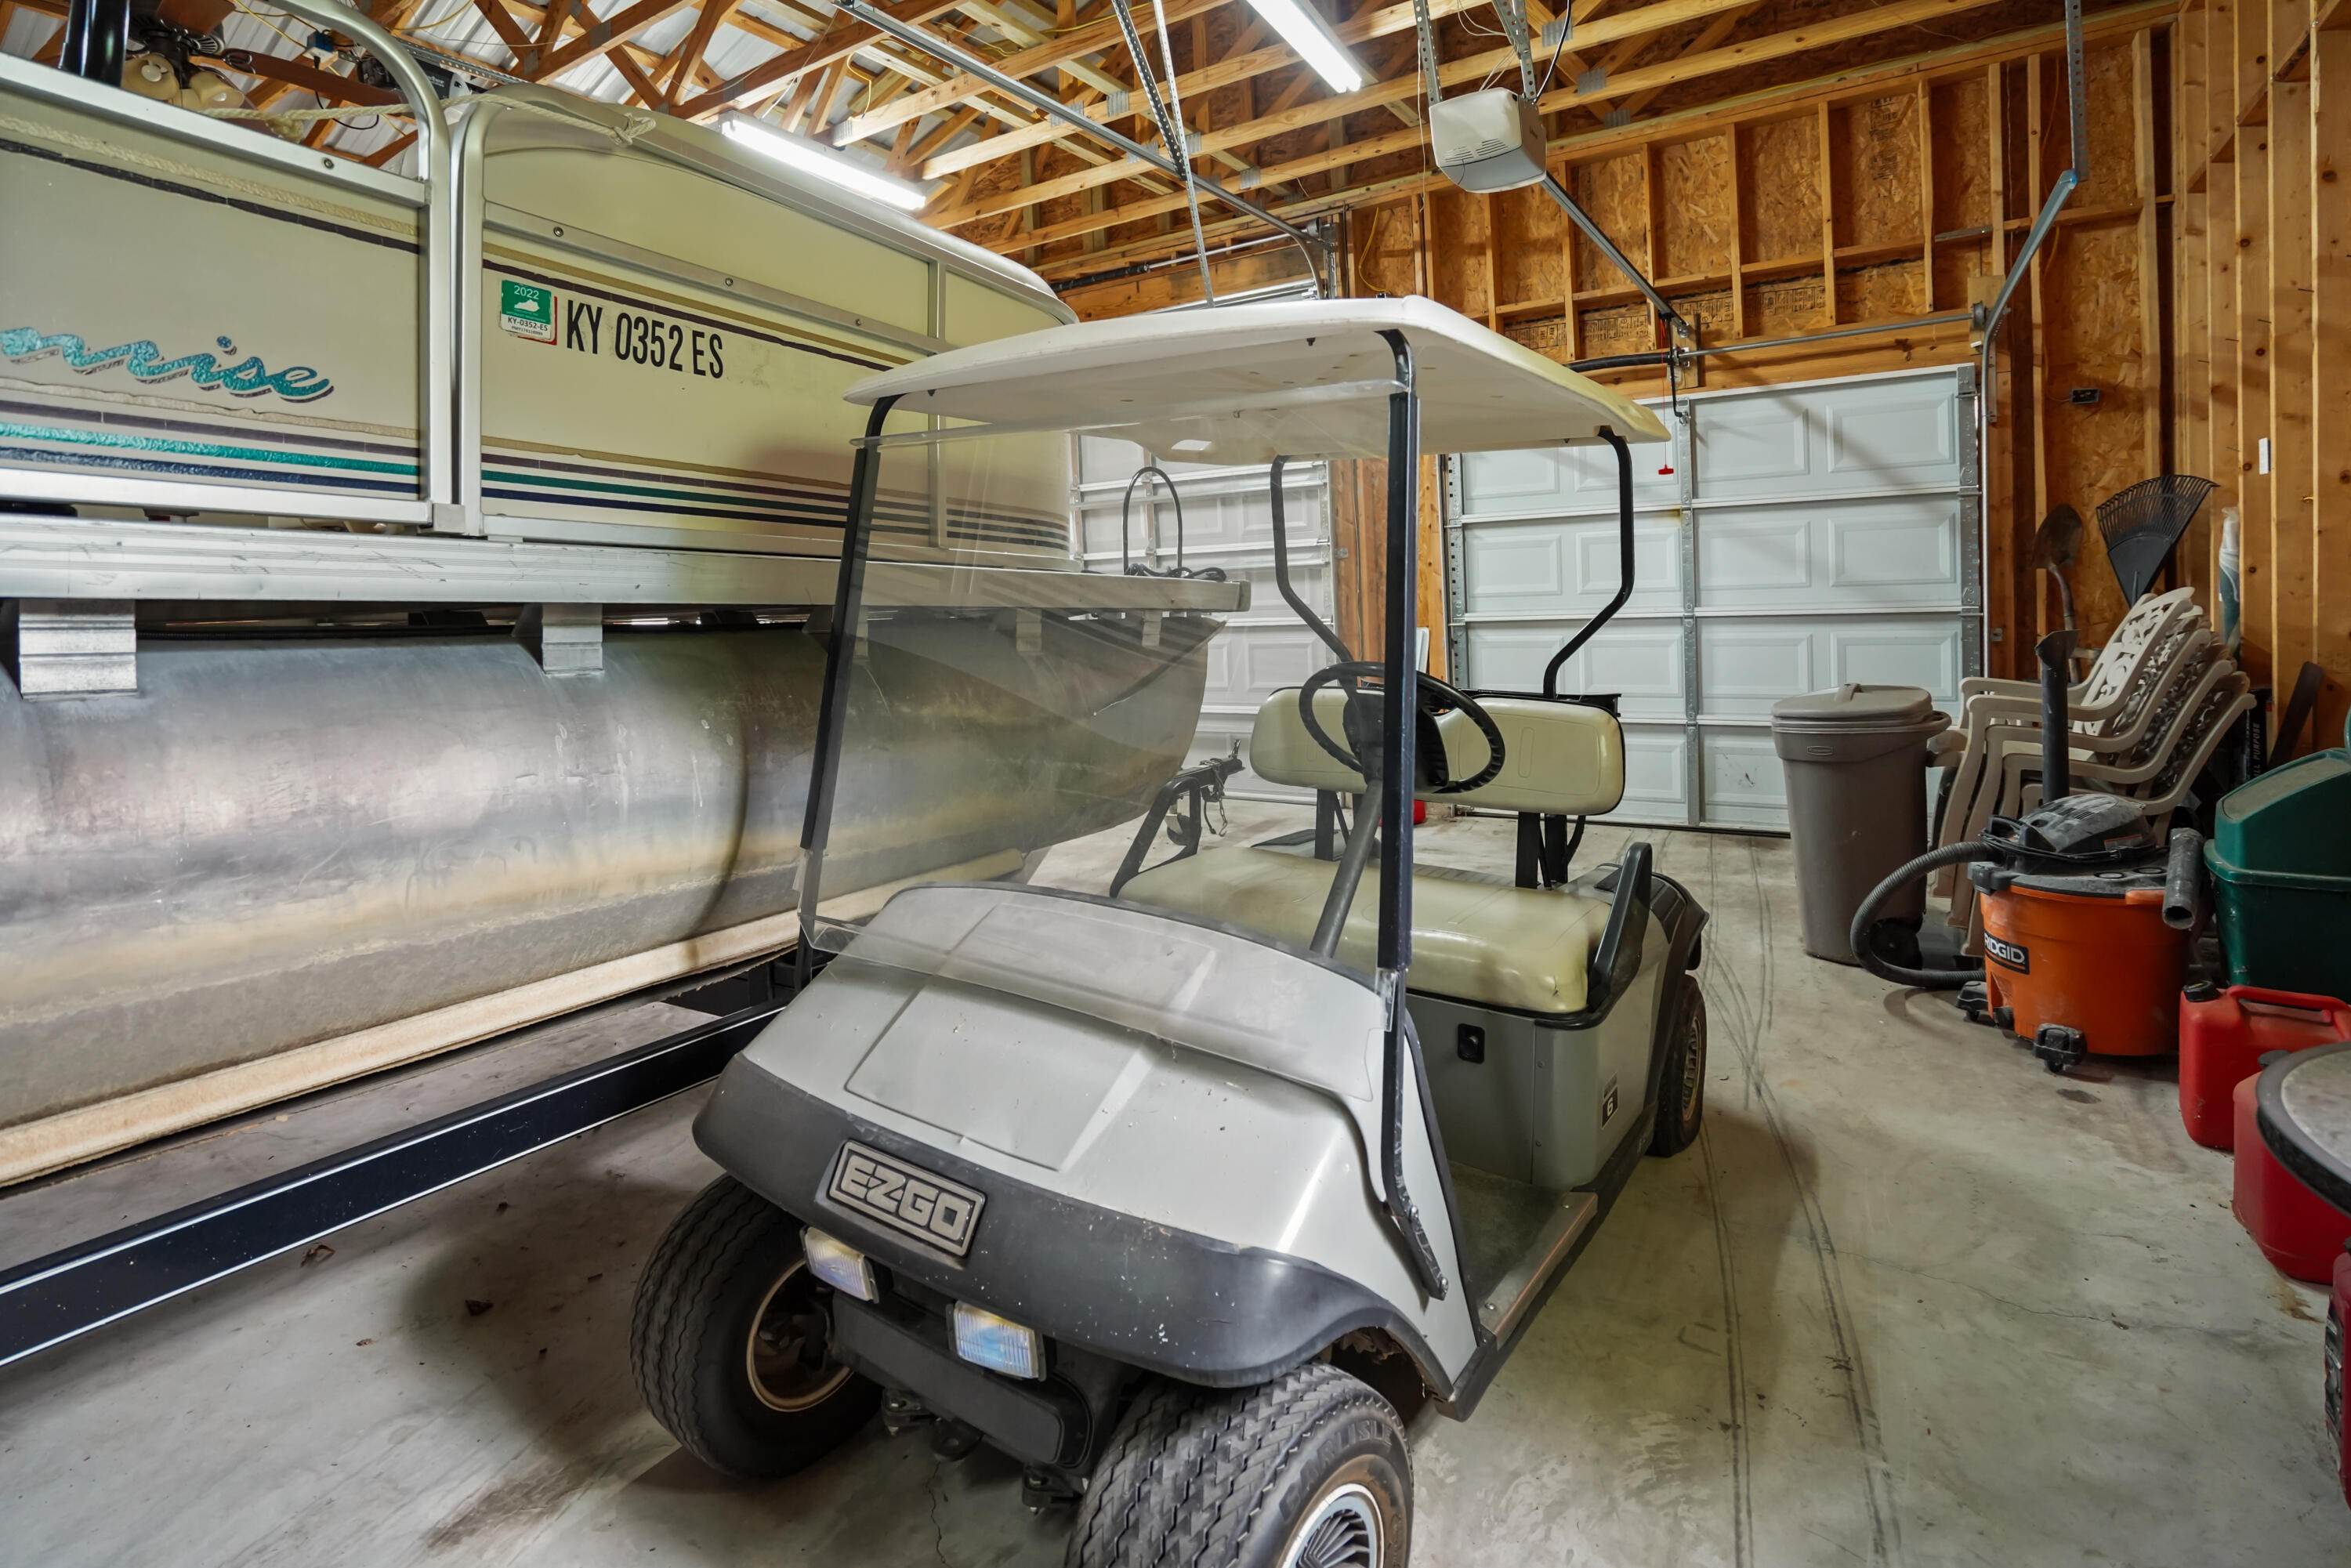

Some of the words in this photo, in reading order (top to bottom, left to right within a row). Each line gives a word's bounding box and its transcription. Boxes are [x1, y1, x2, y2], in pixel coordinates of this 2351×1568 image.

[513, 285, 539, 300] 2022
[507, 316, 549, 331] KY-0352-ES
[567, 299, 603, 354] KY
[614, 312, 683, 371] 0352
[691, 329, 724, 379] ES
[1983, 932, 2026, 964] RIDGID
[1607, 1097, 1614, 1117] 6
